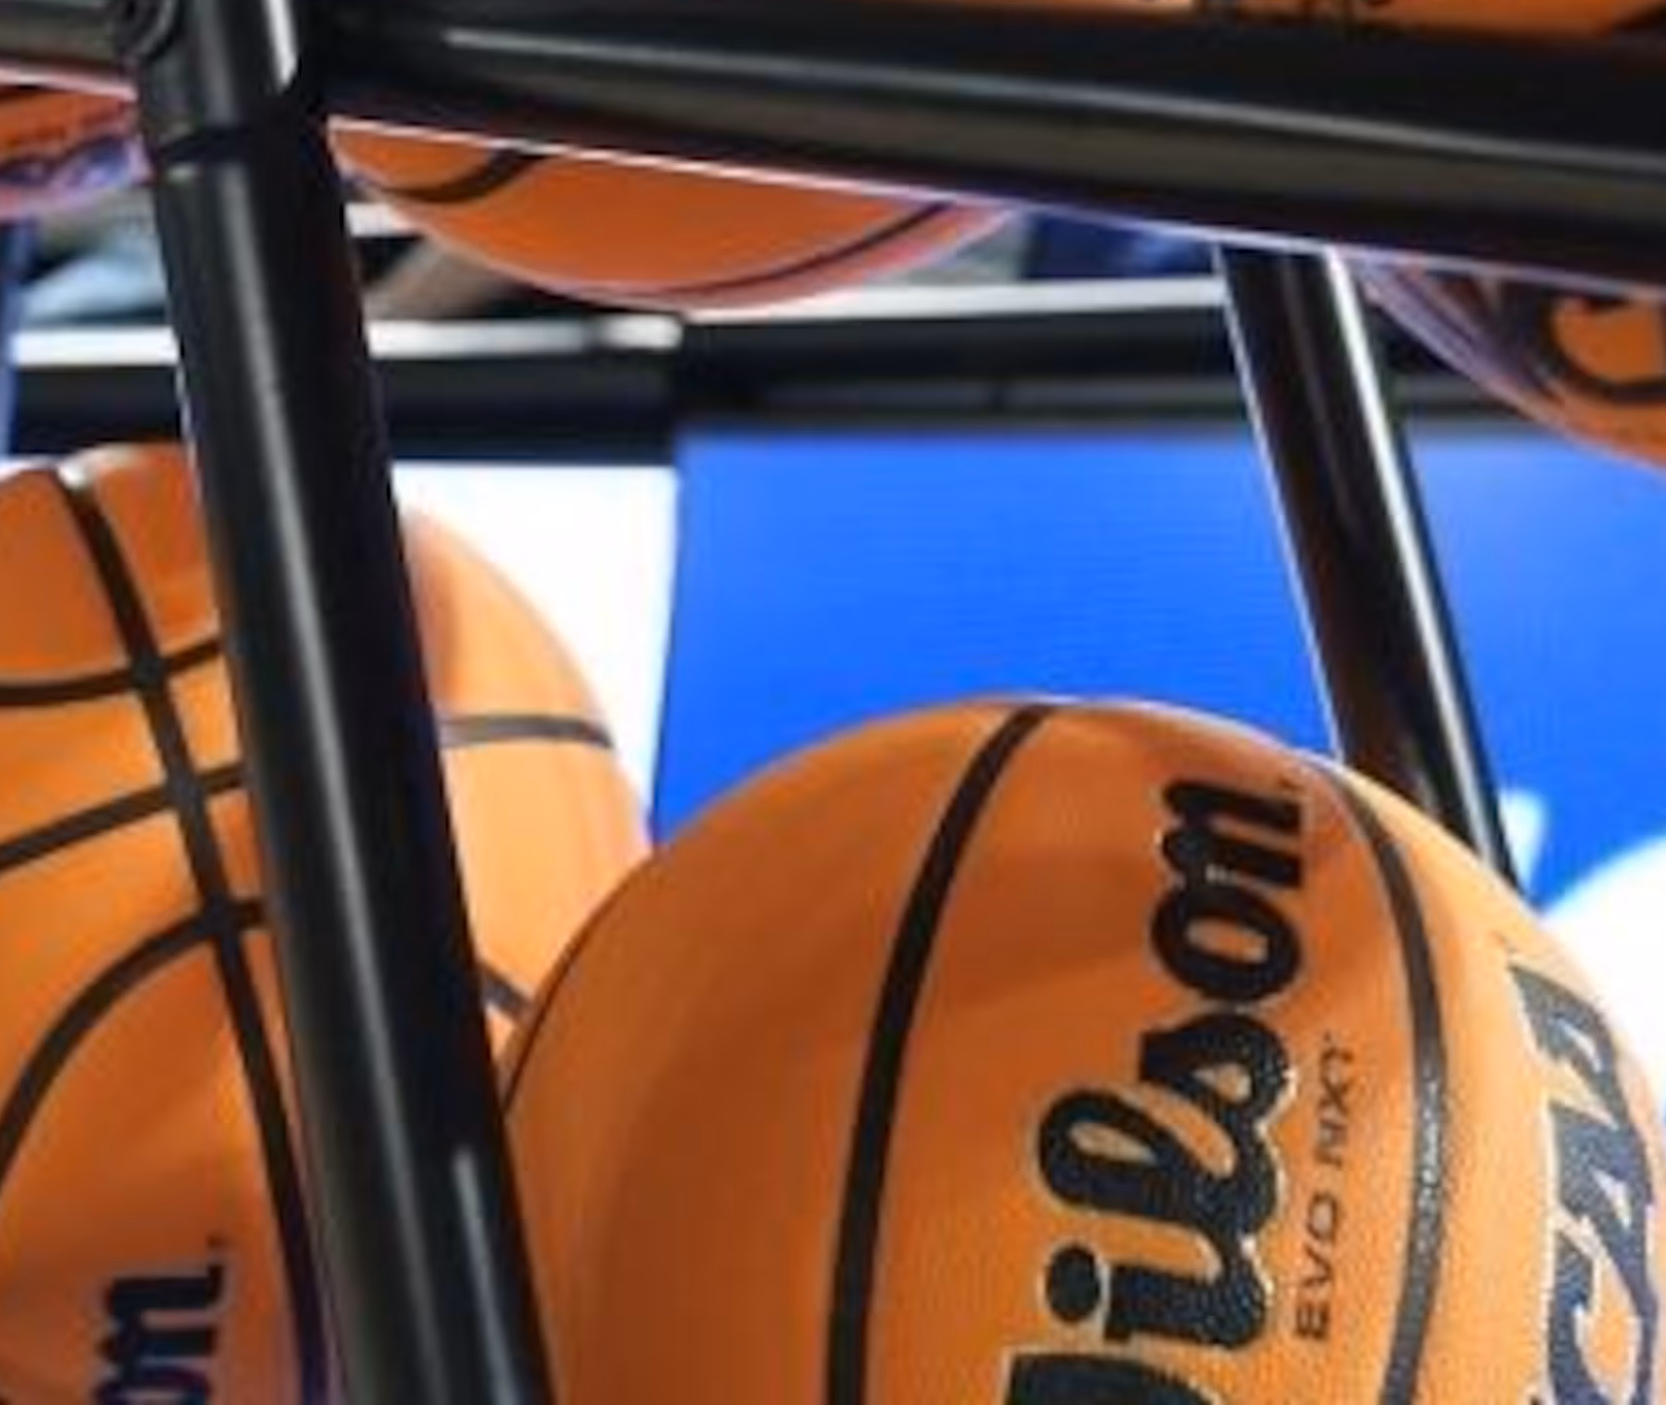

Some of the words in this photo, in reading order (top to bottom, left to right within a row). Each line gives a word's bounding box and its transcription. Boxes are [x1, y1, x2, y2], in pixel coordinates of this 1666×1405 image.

[1000, 778, 1305, 1405] ilson
[1316, 1033, 1356, 1171] NXT
[1508, 960, 1661, 1405] CAA
[1295, 1191, 1344, 1341] EVO
